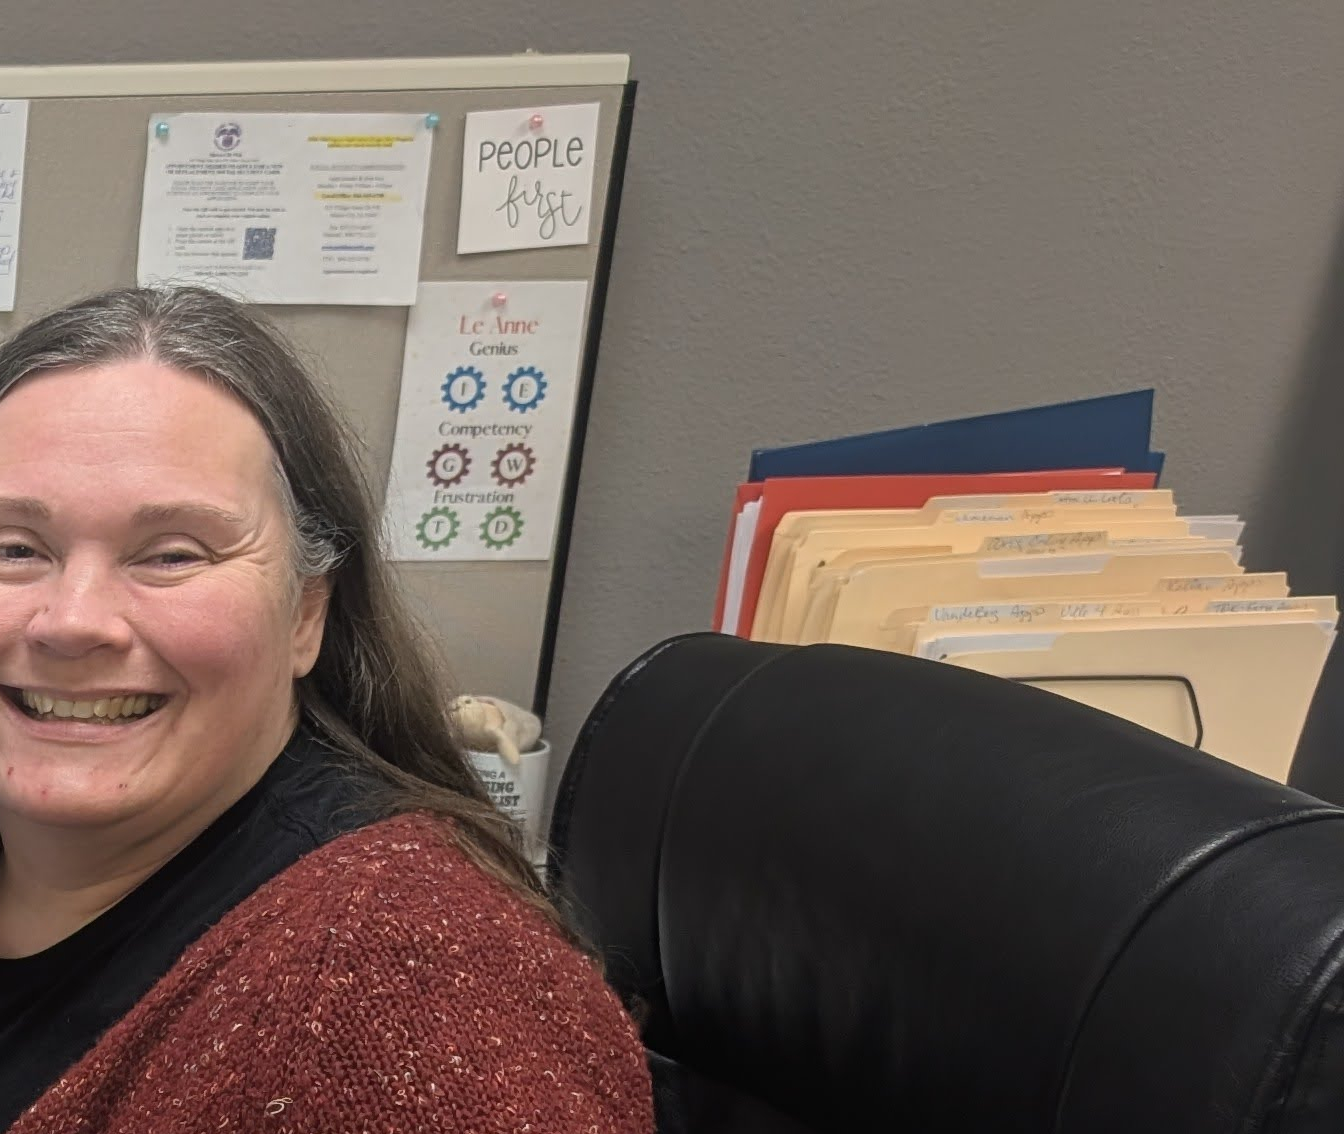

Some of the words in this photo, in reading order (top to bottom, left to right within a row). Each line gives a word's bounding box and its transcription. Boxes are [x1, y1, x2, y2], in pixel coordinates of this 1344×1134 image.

[496, 175, 583, 240] first
[459, 315, 485, 335] Le
[489, 316, 539, 335] Anne
[469, 341, 519, 357] Genius
[519, 383, 530, 399] E
[438, 421, 533, 439] Competency
[442, 458, 456, 473] G
[506, 458, 524, 472] W
[433, 490, 515, 504] Frustration
[433, 520, 445, 534] T
[494, 520, 509, 535] D
